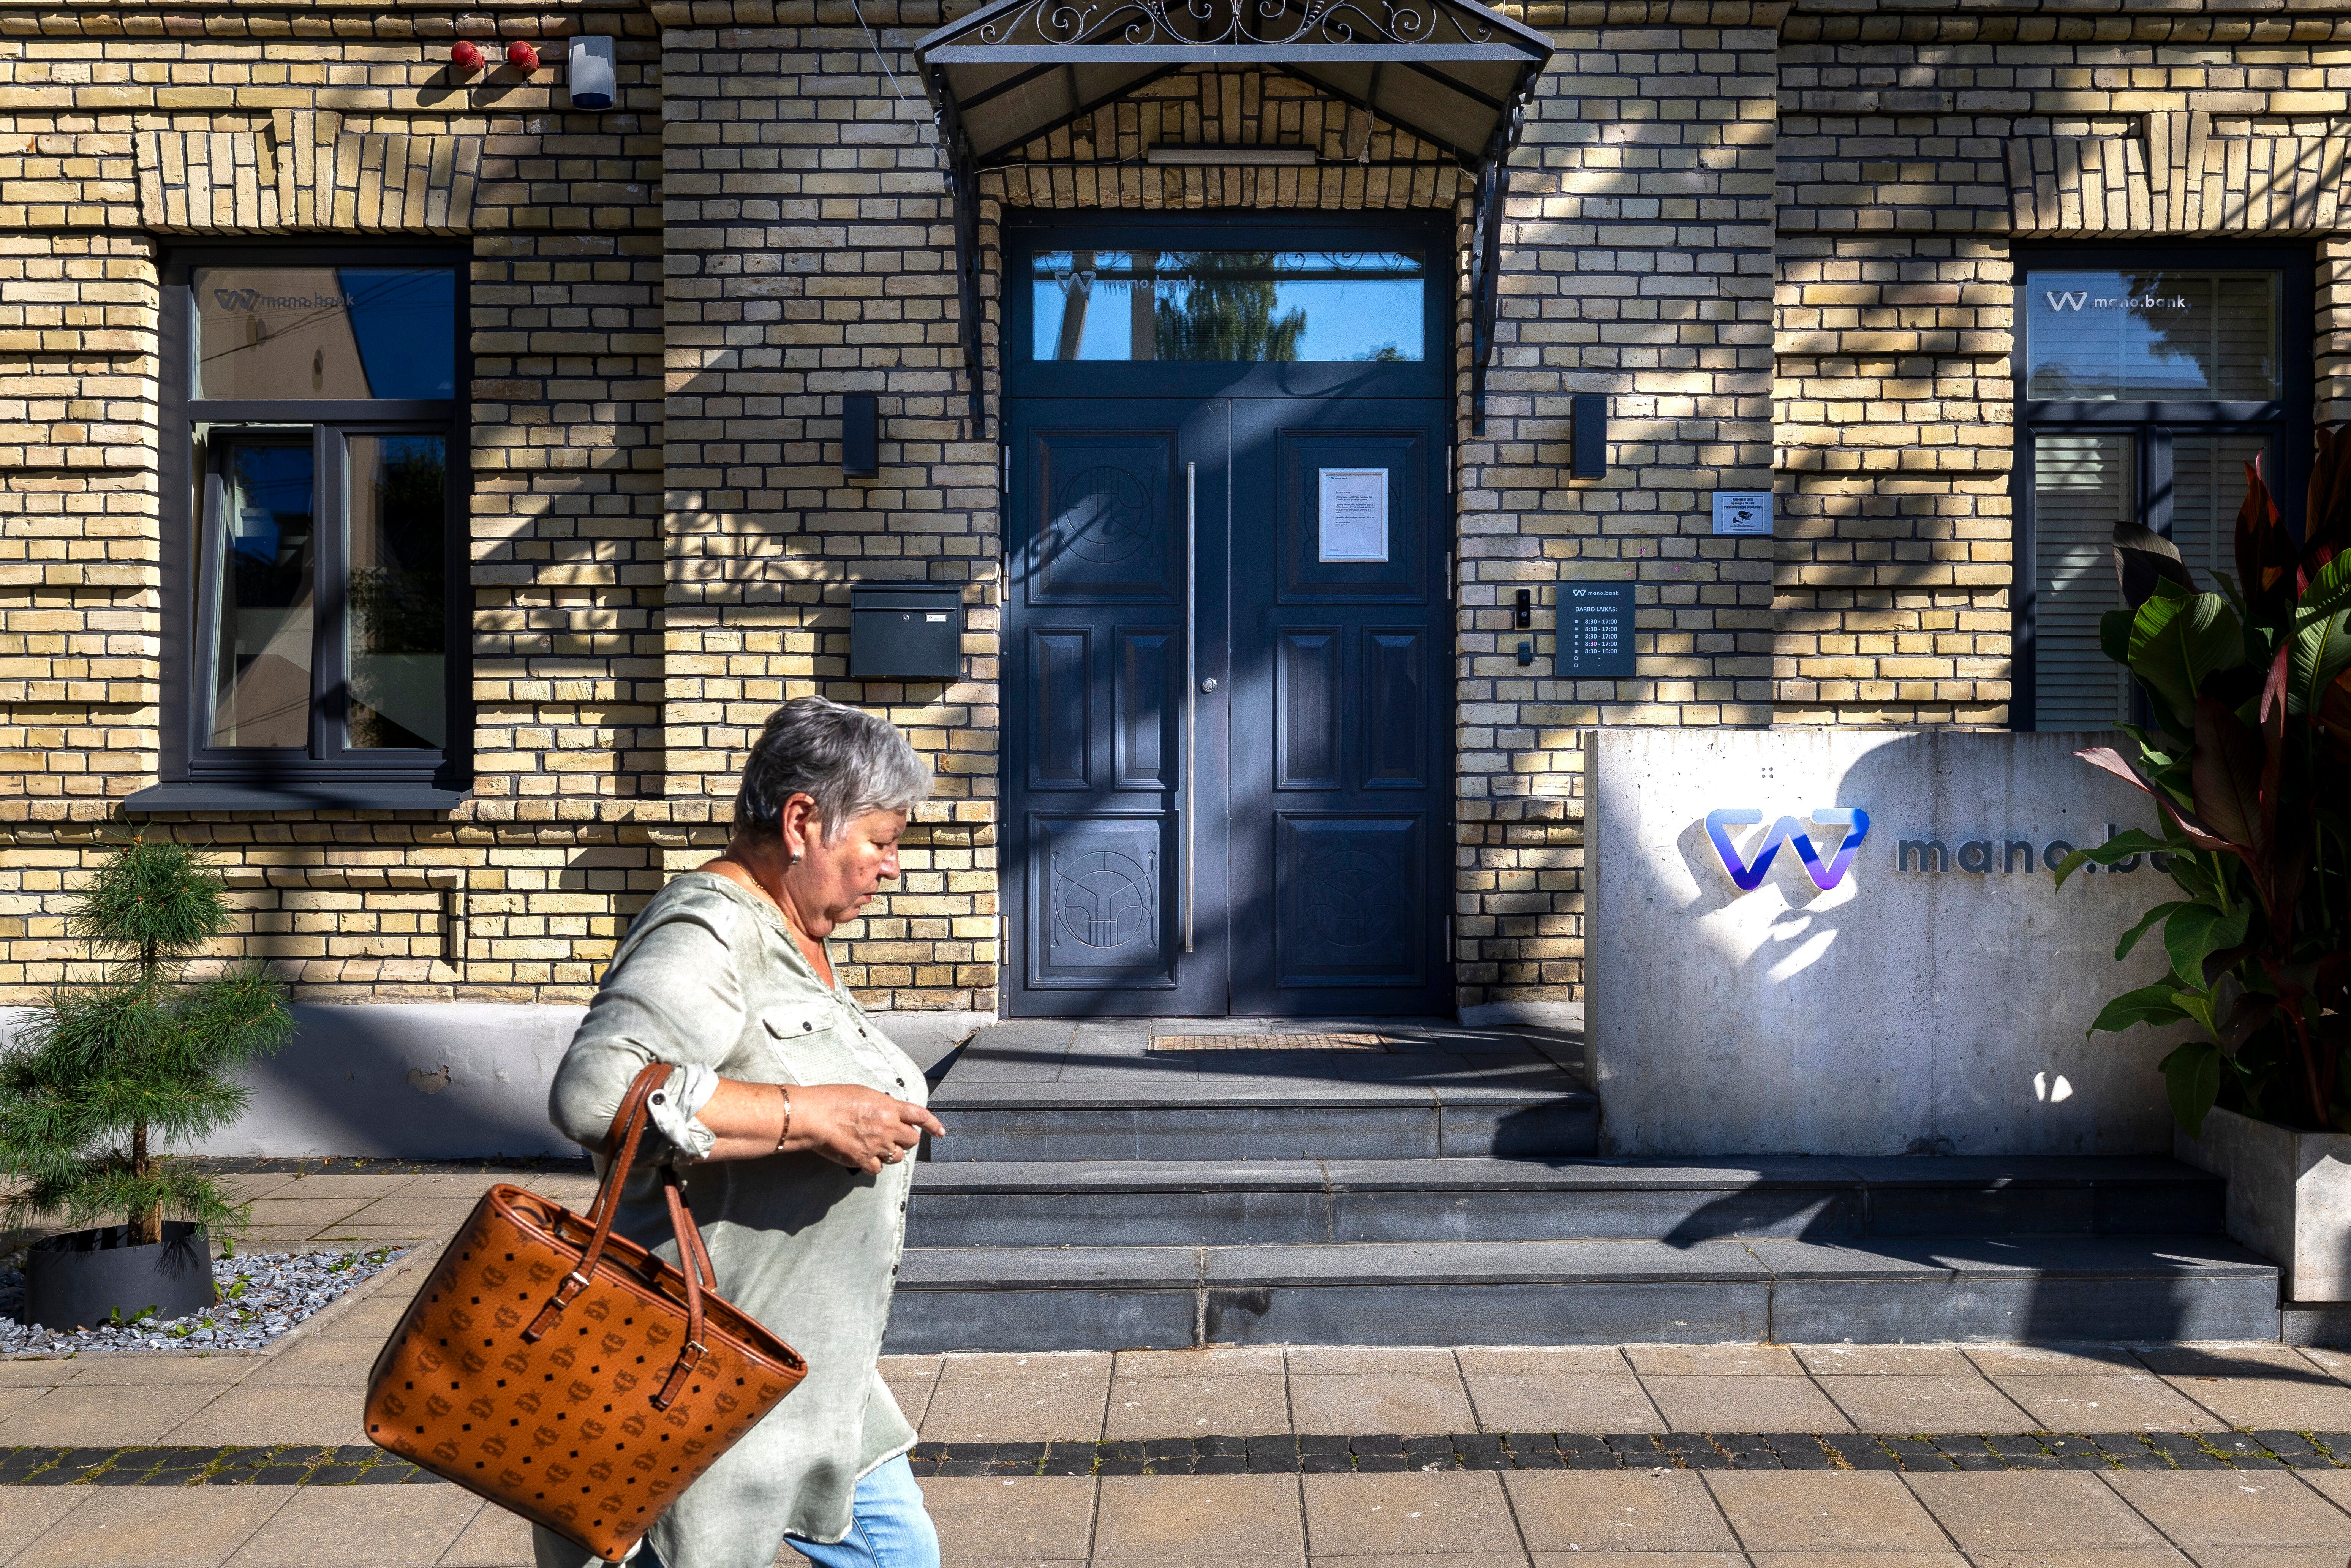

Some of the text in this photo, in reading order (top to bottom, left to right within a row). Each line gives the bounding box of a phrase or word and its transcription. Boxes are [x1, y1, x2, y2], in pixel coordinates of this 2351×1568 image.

[1103, 275, 1197, 289] mano.bank
[262, 292, 355, 305] mano.bank
[2094, 294, 2186, 307] mano.bank
